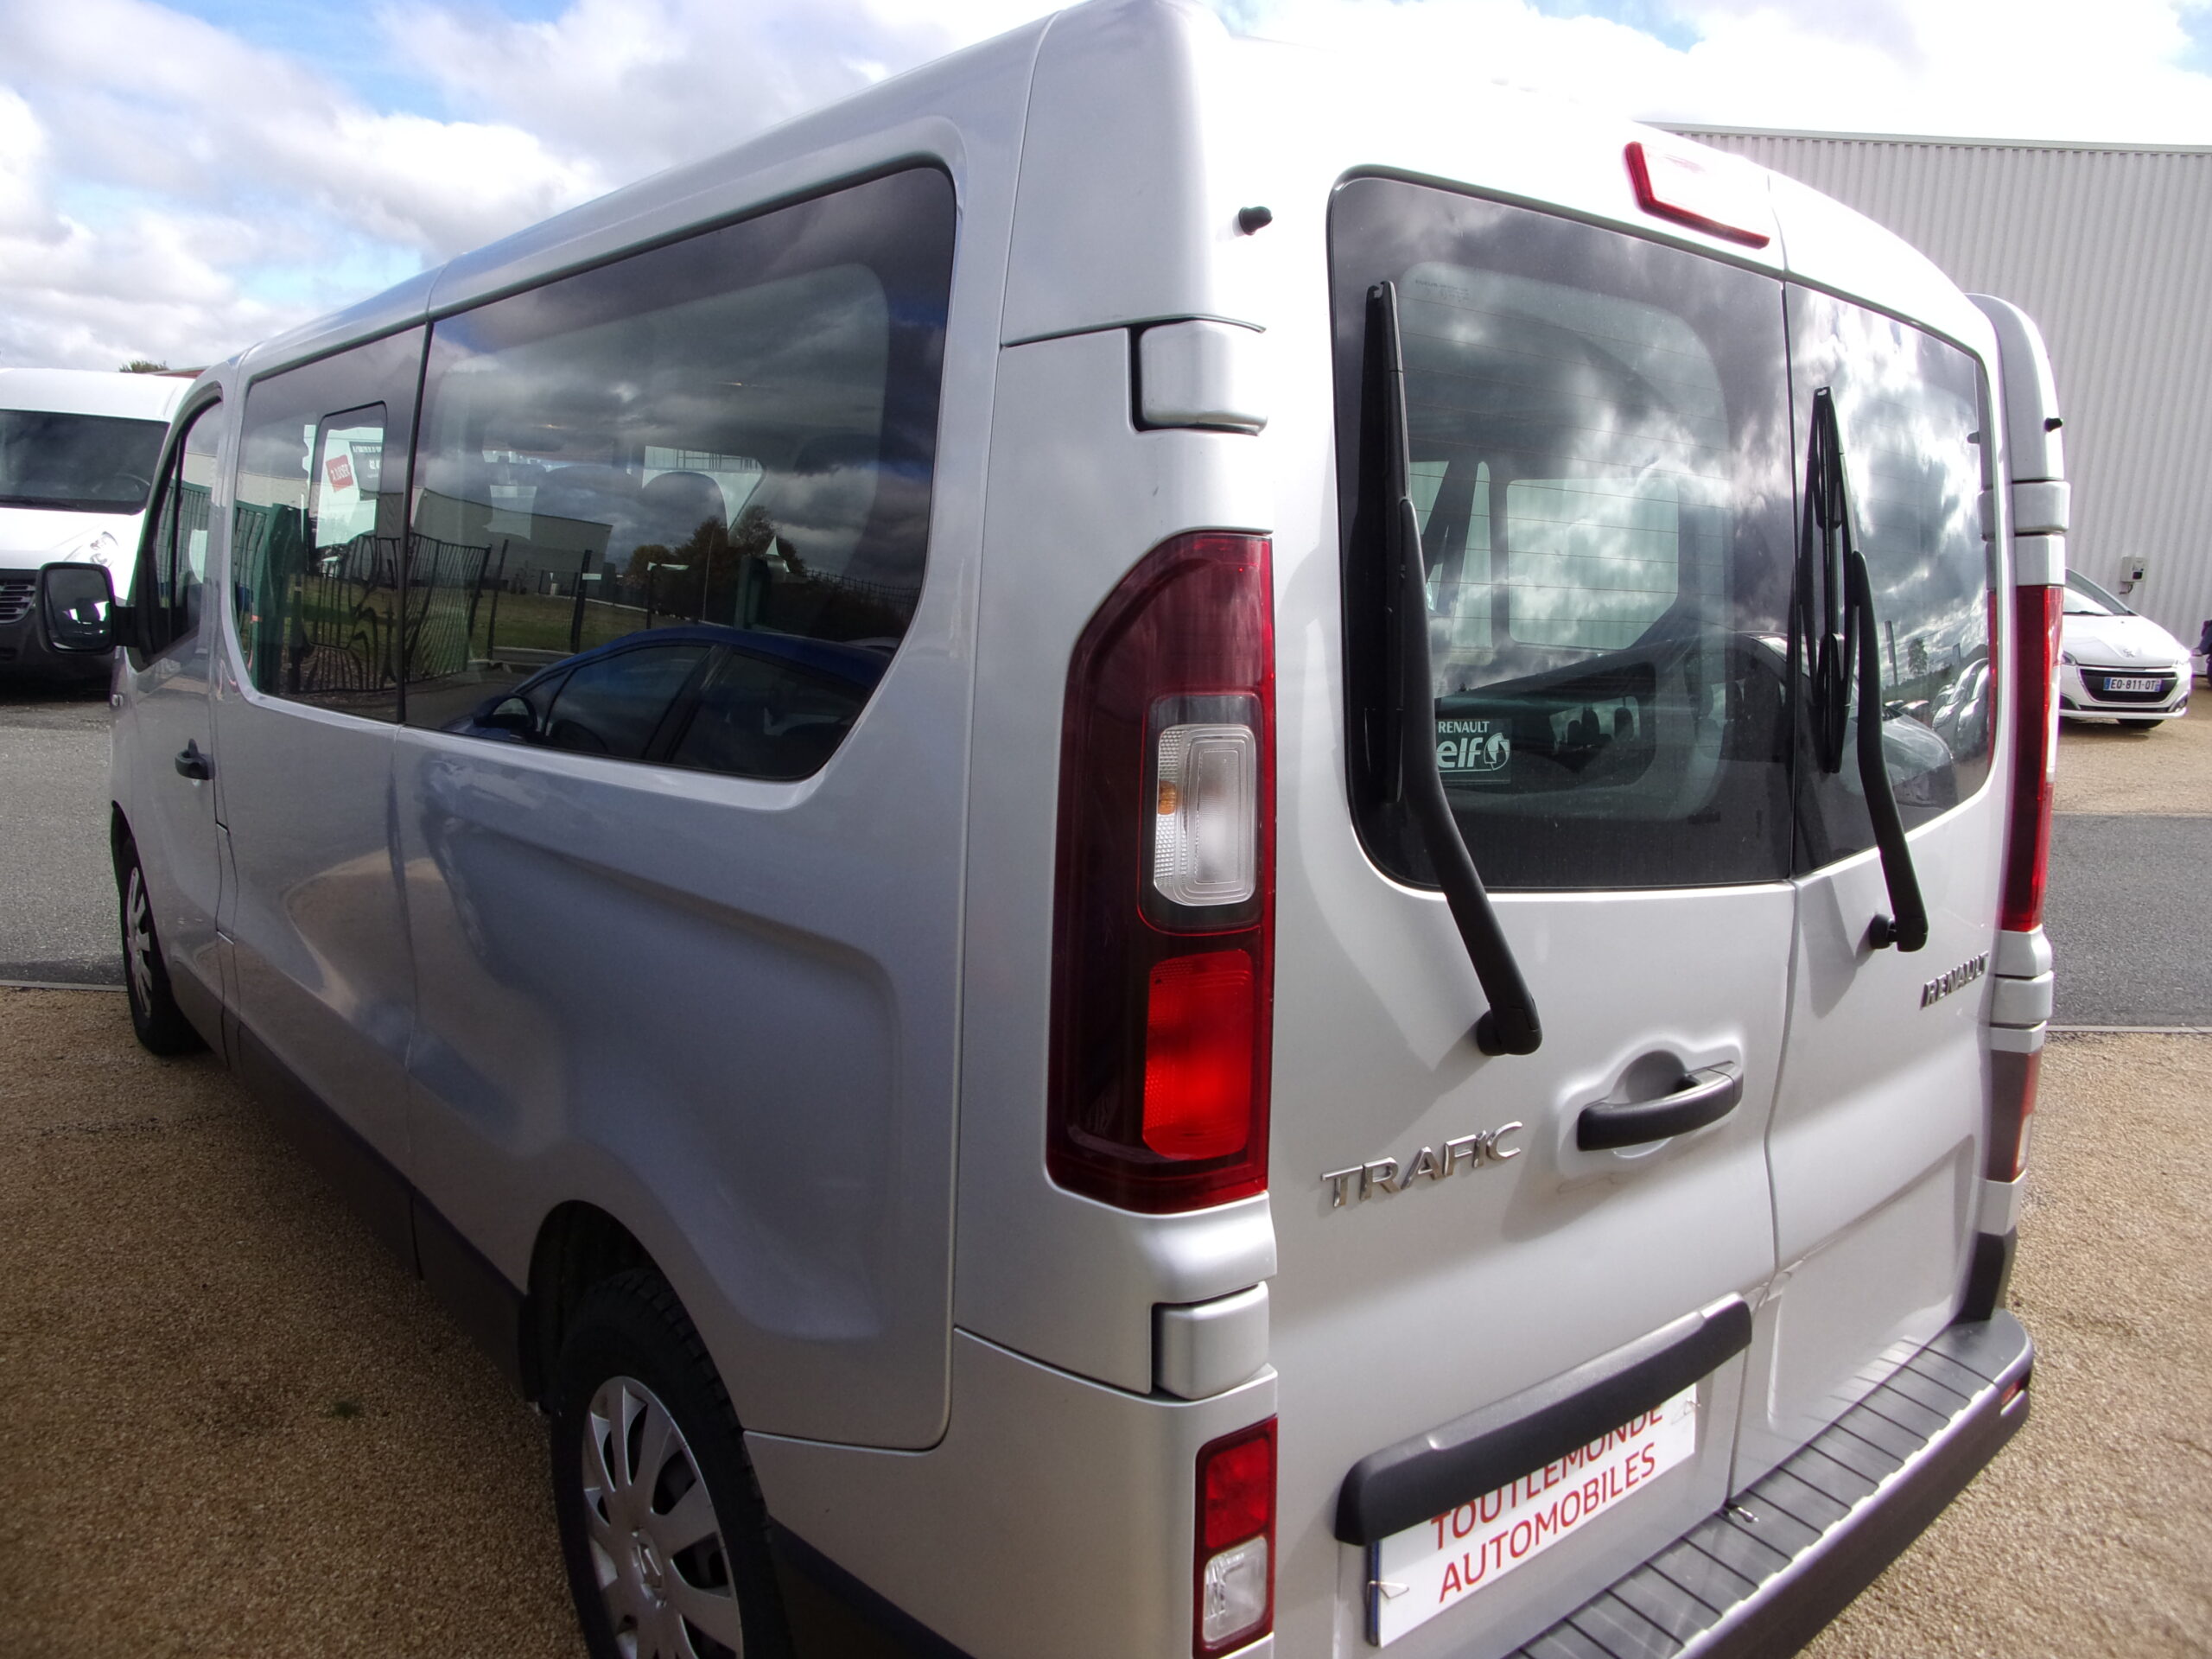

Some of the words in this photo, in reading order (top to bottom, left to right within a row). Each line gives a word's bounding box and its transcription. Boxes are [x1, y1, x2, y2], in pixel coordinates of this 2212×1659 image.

[1436, 737, 1484, 768] elf
[1437, 721, 1490, 733] RENAULT
[1920, 950, 1989, 1009] RENAULT
[1321, 1121, 1522, 1208] TRAFIC
[1439, 1442, 1656, 1603] AUTOMOBILES
